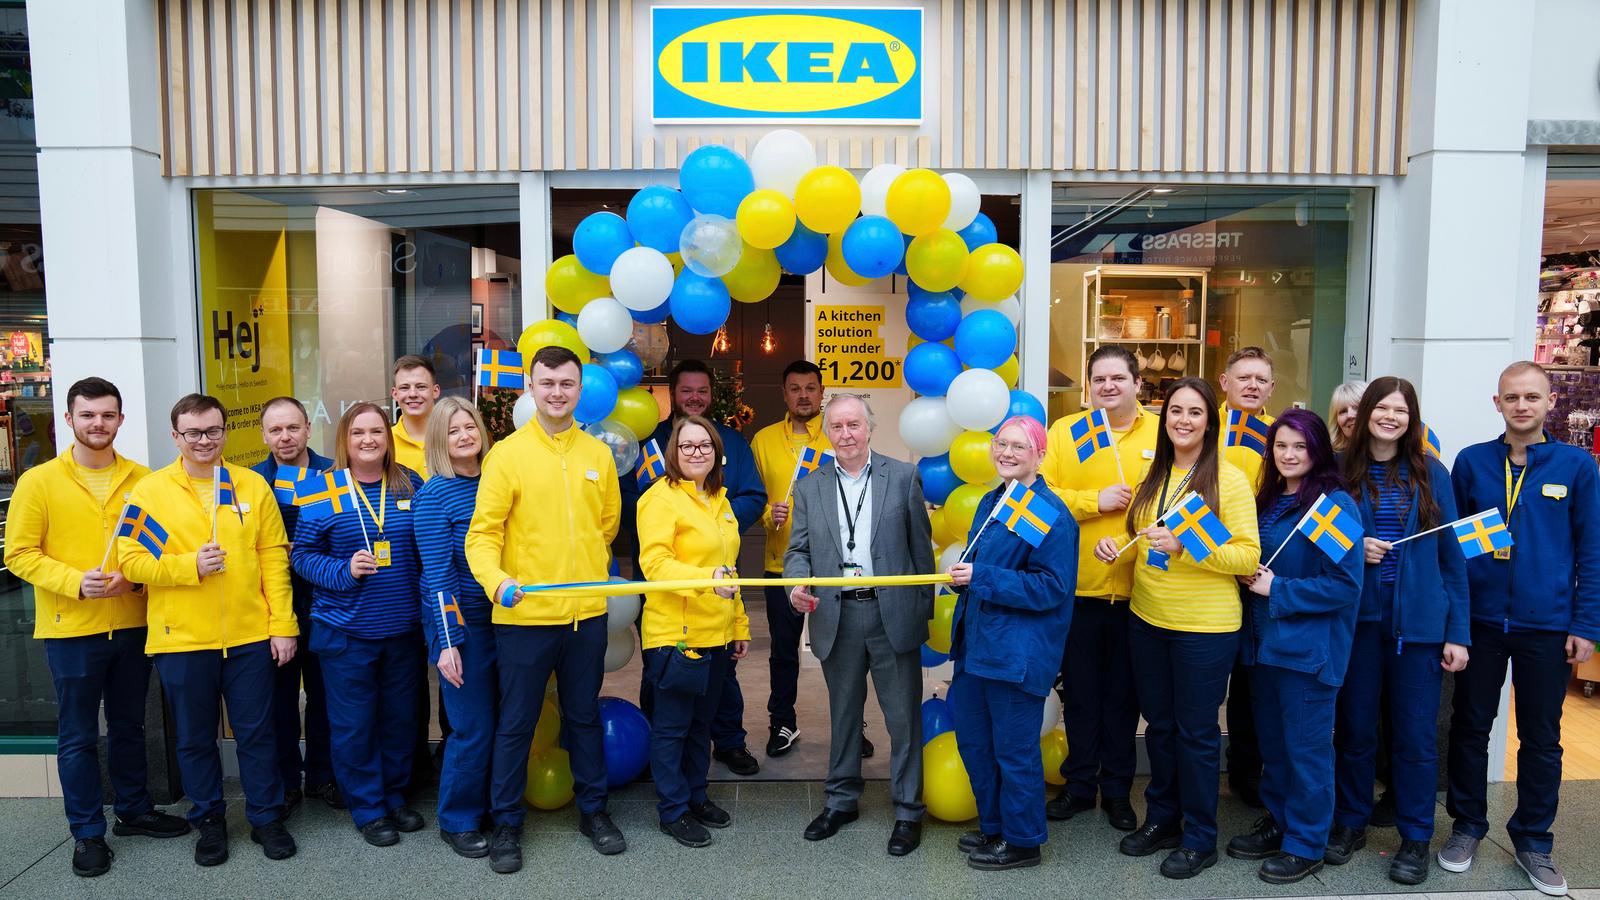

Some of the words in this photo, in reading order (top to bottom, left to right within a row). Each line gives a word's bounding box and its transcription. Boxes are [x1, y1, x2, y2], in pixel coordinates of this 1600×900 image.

[818, 310, 827, 321] A
[831, 310, 881, 322] kitchen
[818, 326, 872, 338] solution
[818, 343, 837, 354] for
[841, 343, 881, 354] under
[249, 404, 261, 414] IKEA
[231, 420, 236, 430] &
[237, 419, 251, 429] order
